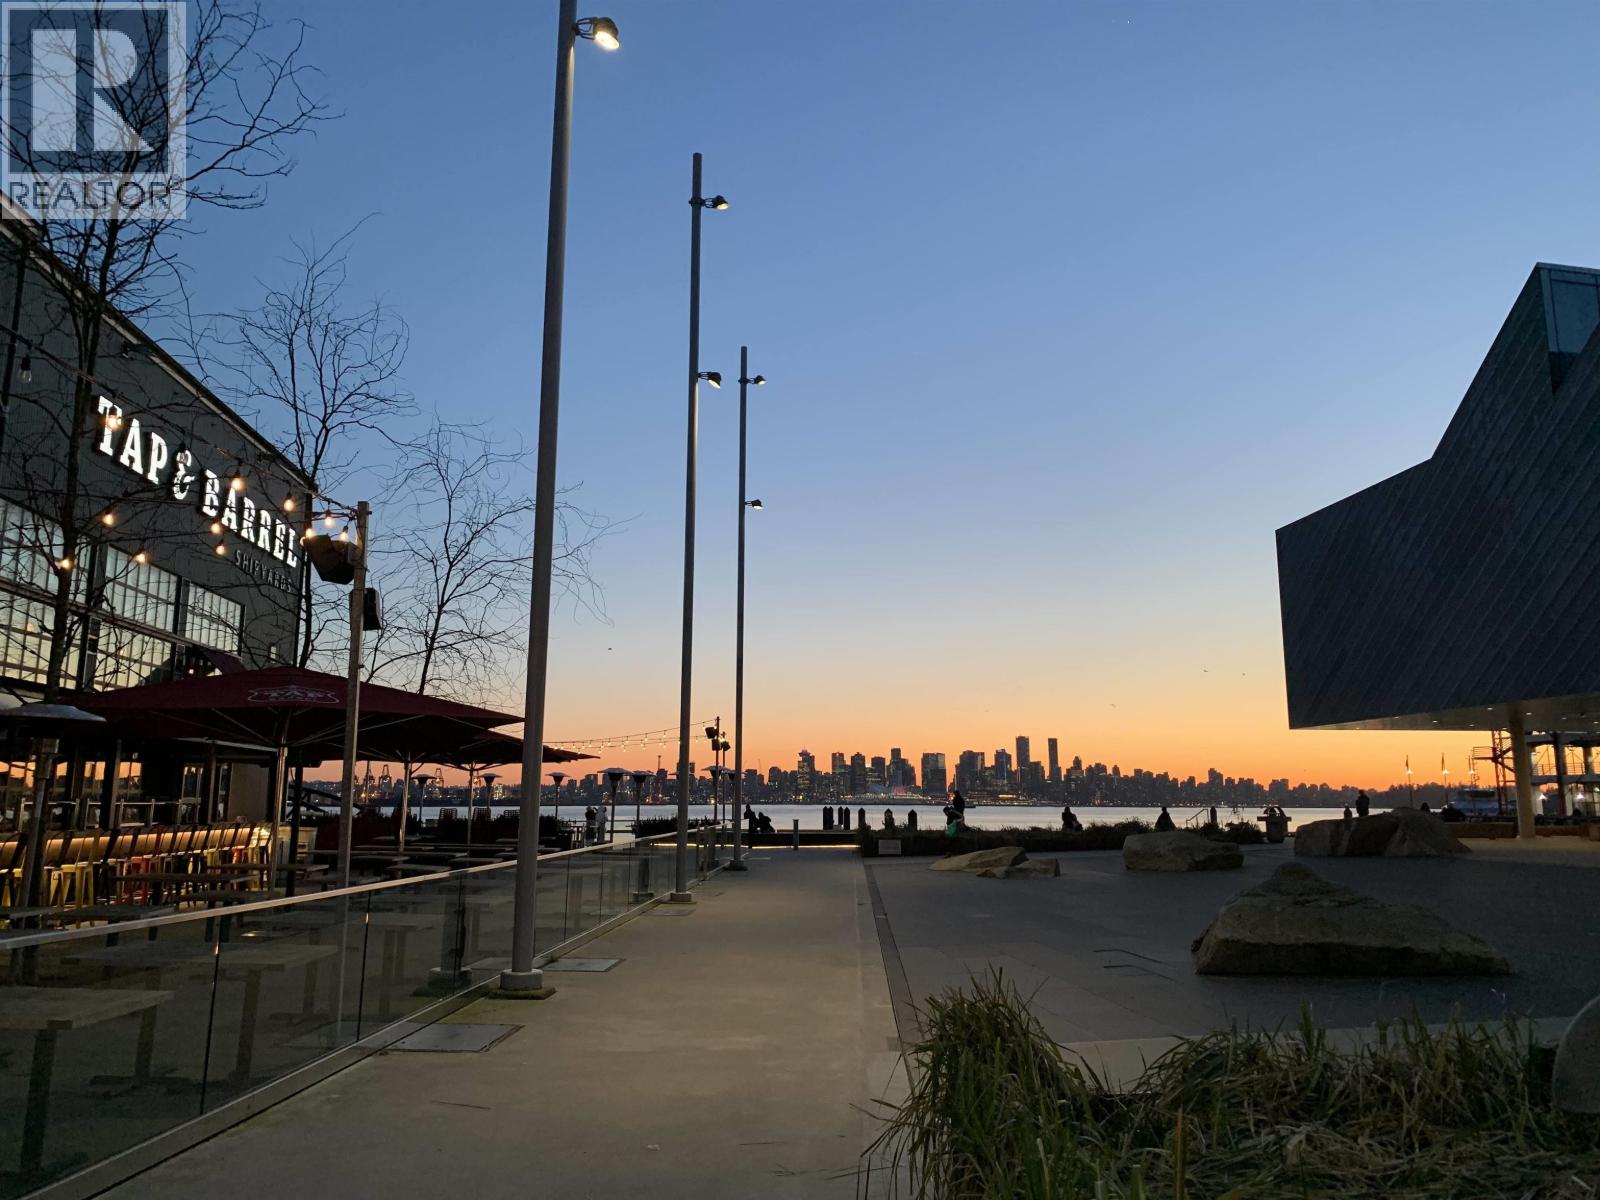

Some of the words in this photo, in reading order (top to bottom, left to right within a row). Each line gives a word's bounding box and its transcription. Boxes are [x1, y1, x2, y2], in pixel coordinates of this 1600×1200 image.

[97, 395, 169, 486] TAP
[172, 449, 195, 500] &
[201, 468, 298, 568] BARREL
[235, 549, 292, 593] SHIPYARDS
